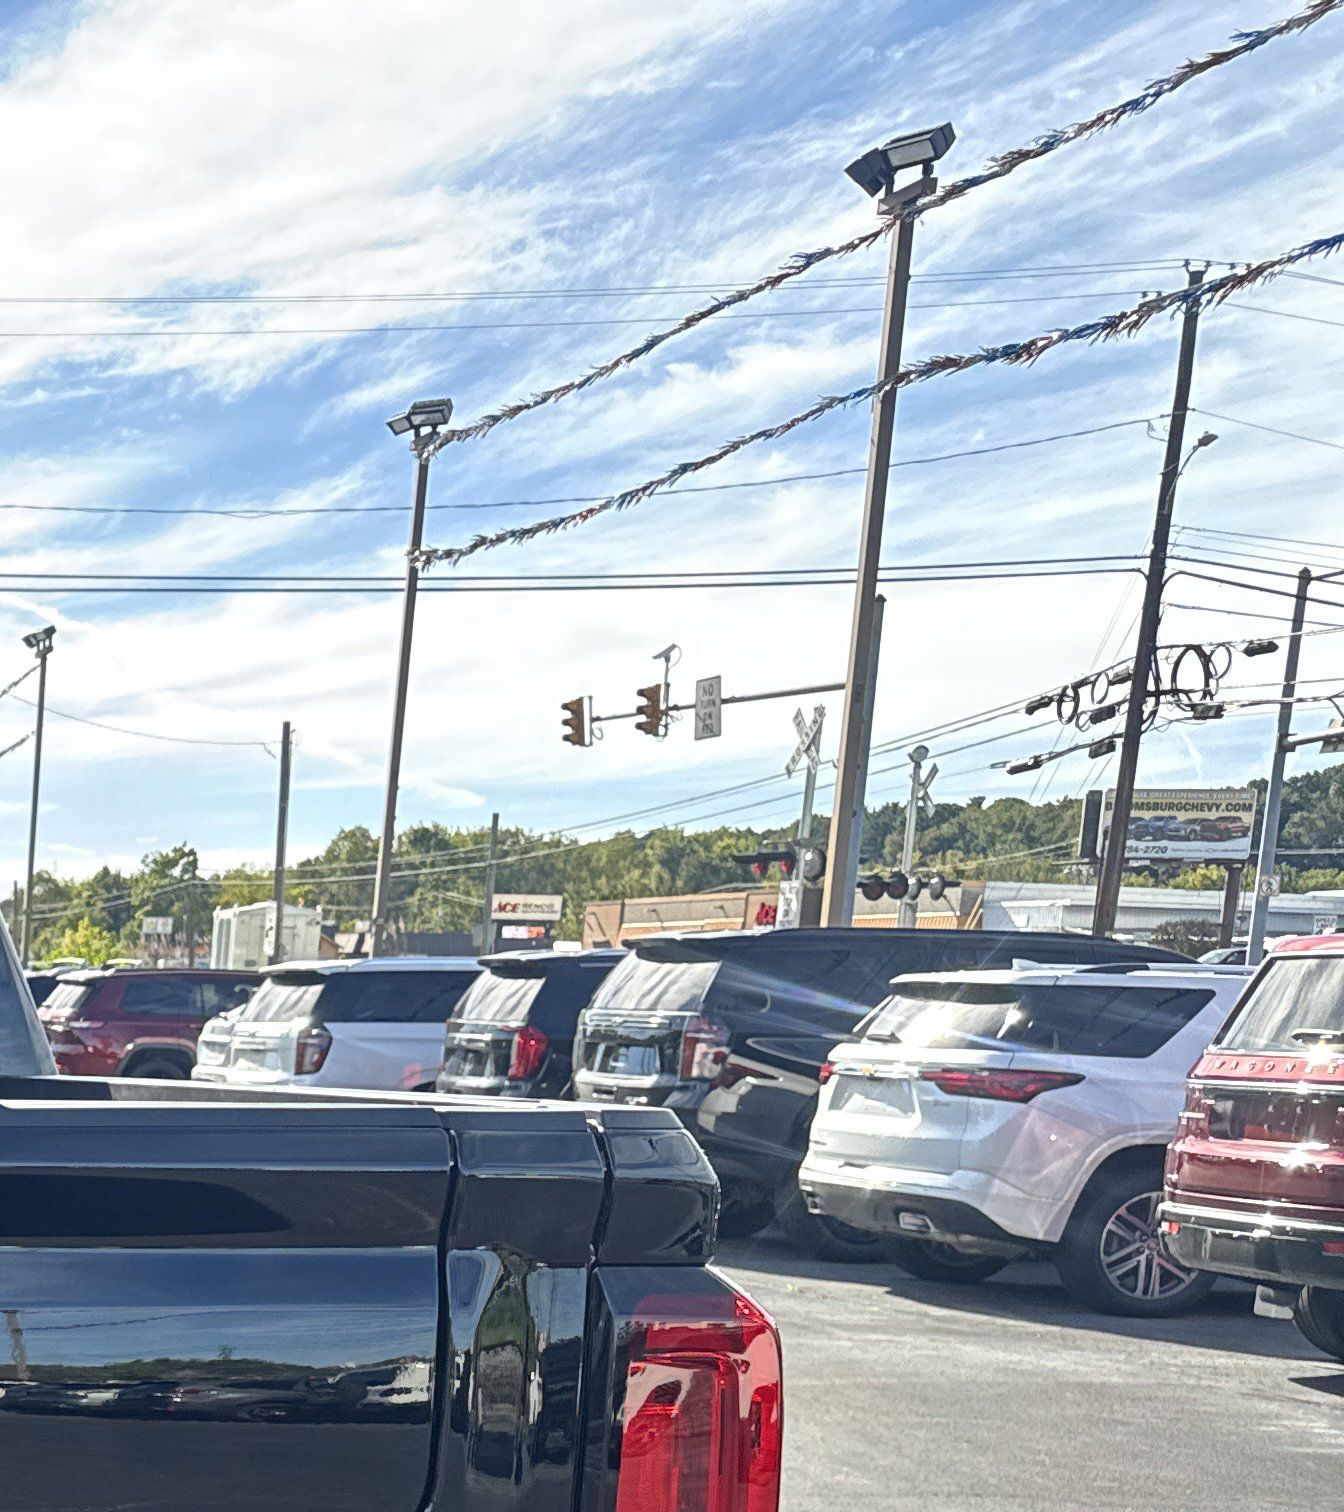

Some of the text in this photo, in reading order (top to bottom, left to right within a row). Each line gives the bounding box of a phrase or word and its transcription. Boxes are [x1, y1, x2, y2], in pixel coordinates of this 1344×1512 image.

[702, 683, 714, 697] NO
[1105, 802, 1253, 812] BMSBURGCHEVY.COM
[493, 901, 520, 913] ACE
[1213, 1059, 1344, 1075] WAGONEE
